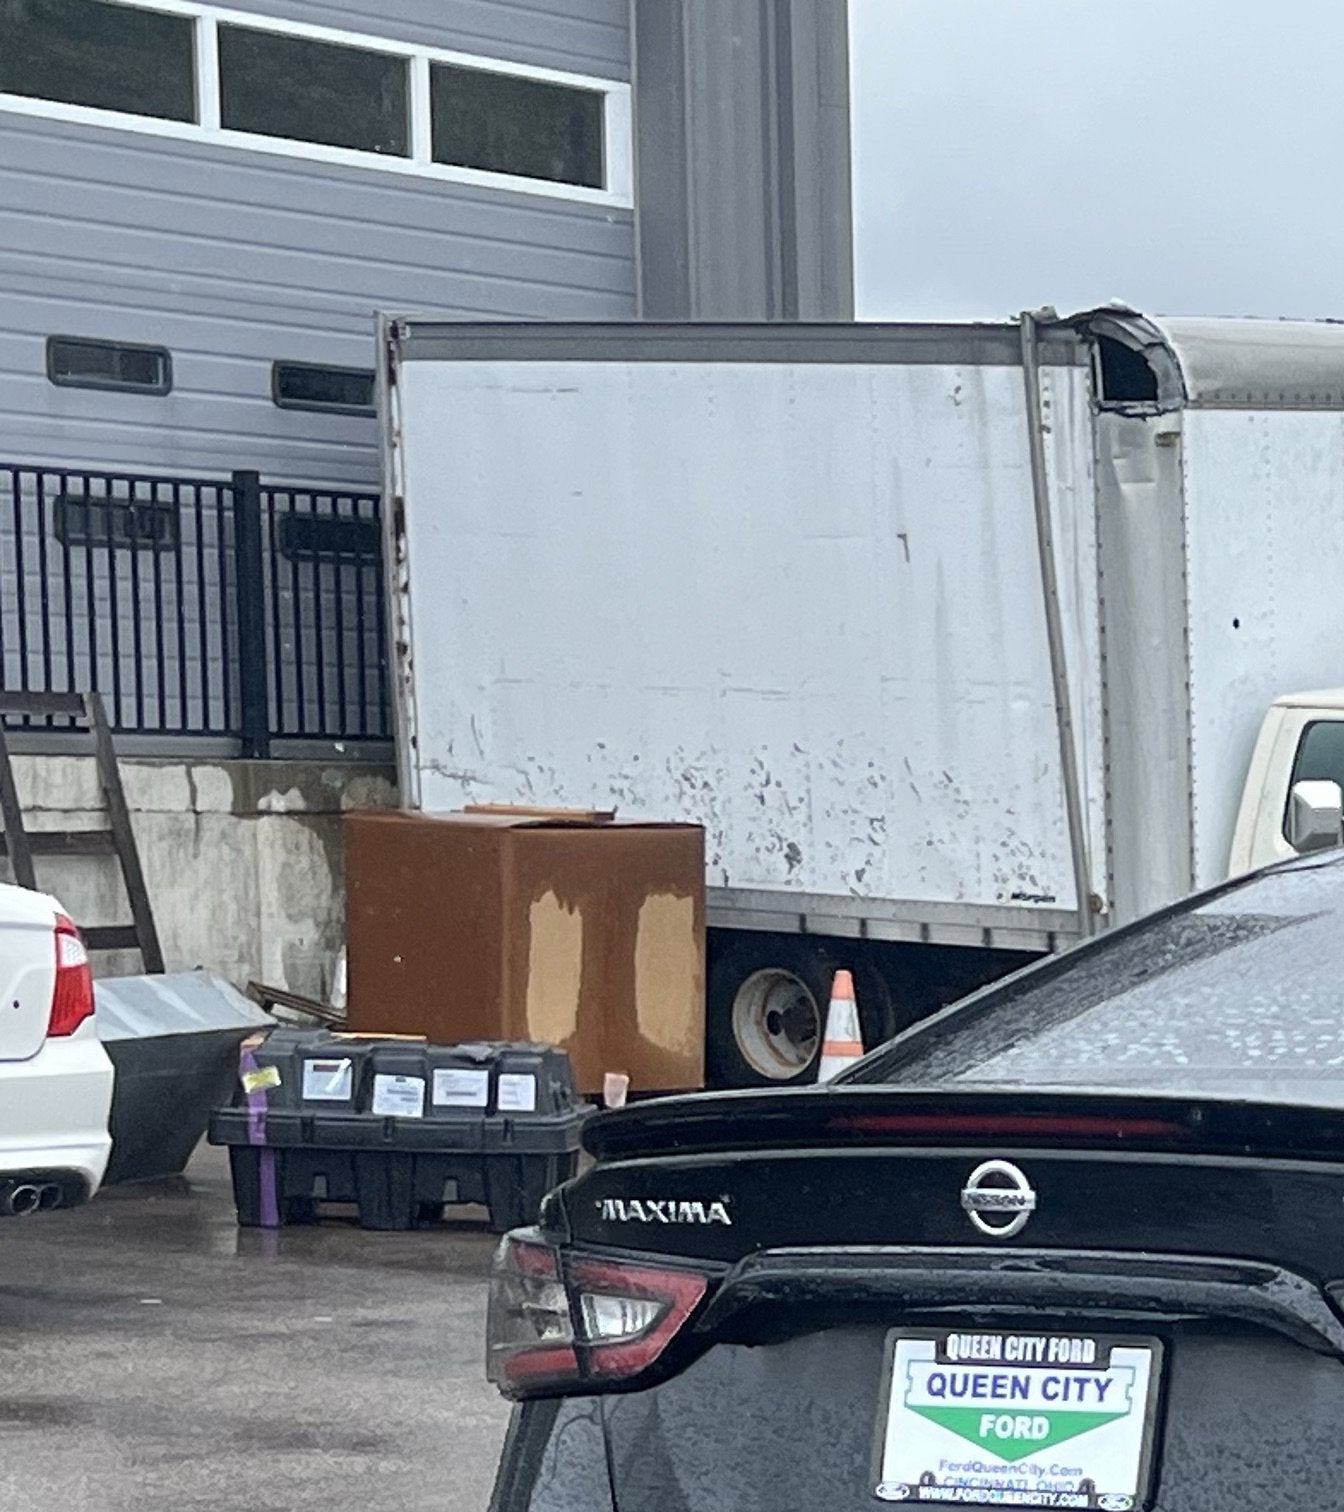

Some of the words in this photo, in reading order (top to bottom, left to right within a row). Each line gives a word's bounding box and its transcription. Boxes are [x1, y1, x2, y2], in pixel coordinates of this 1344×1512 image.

[601, 1198, 732, 1226] MAXIMA
[946, 1333, 1003, 1361] QUEEN
[1005, 1336, 1047, 1362] CITY
[1048, 1337, 1096, 1364] FORD
[926, 1372, 1030, 1401] QUEEN
[1040, 1376, 1114, 1403] CITY
[979, 1414, 1050, 1440] FORD
